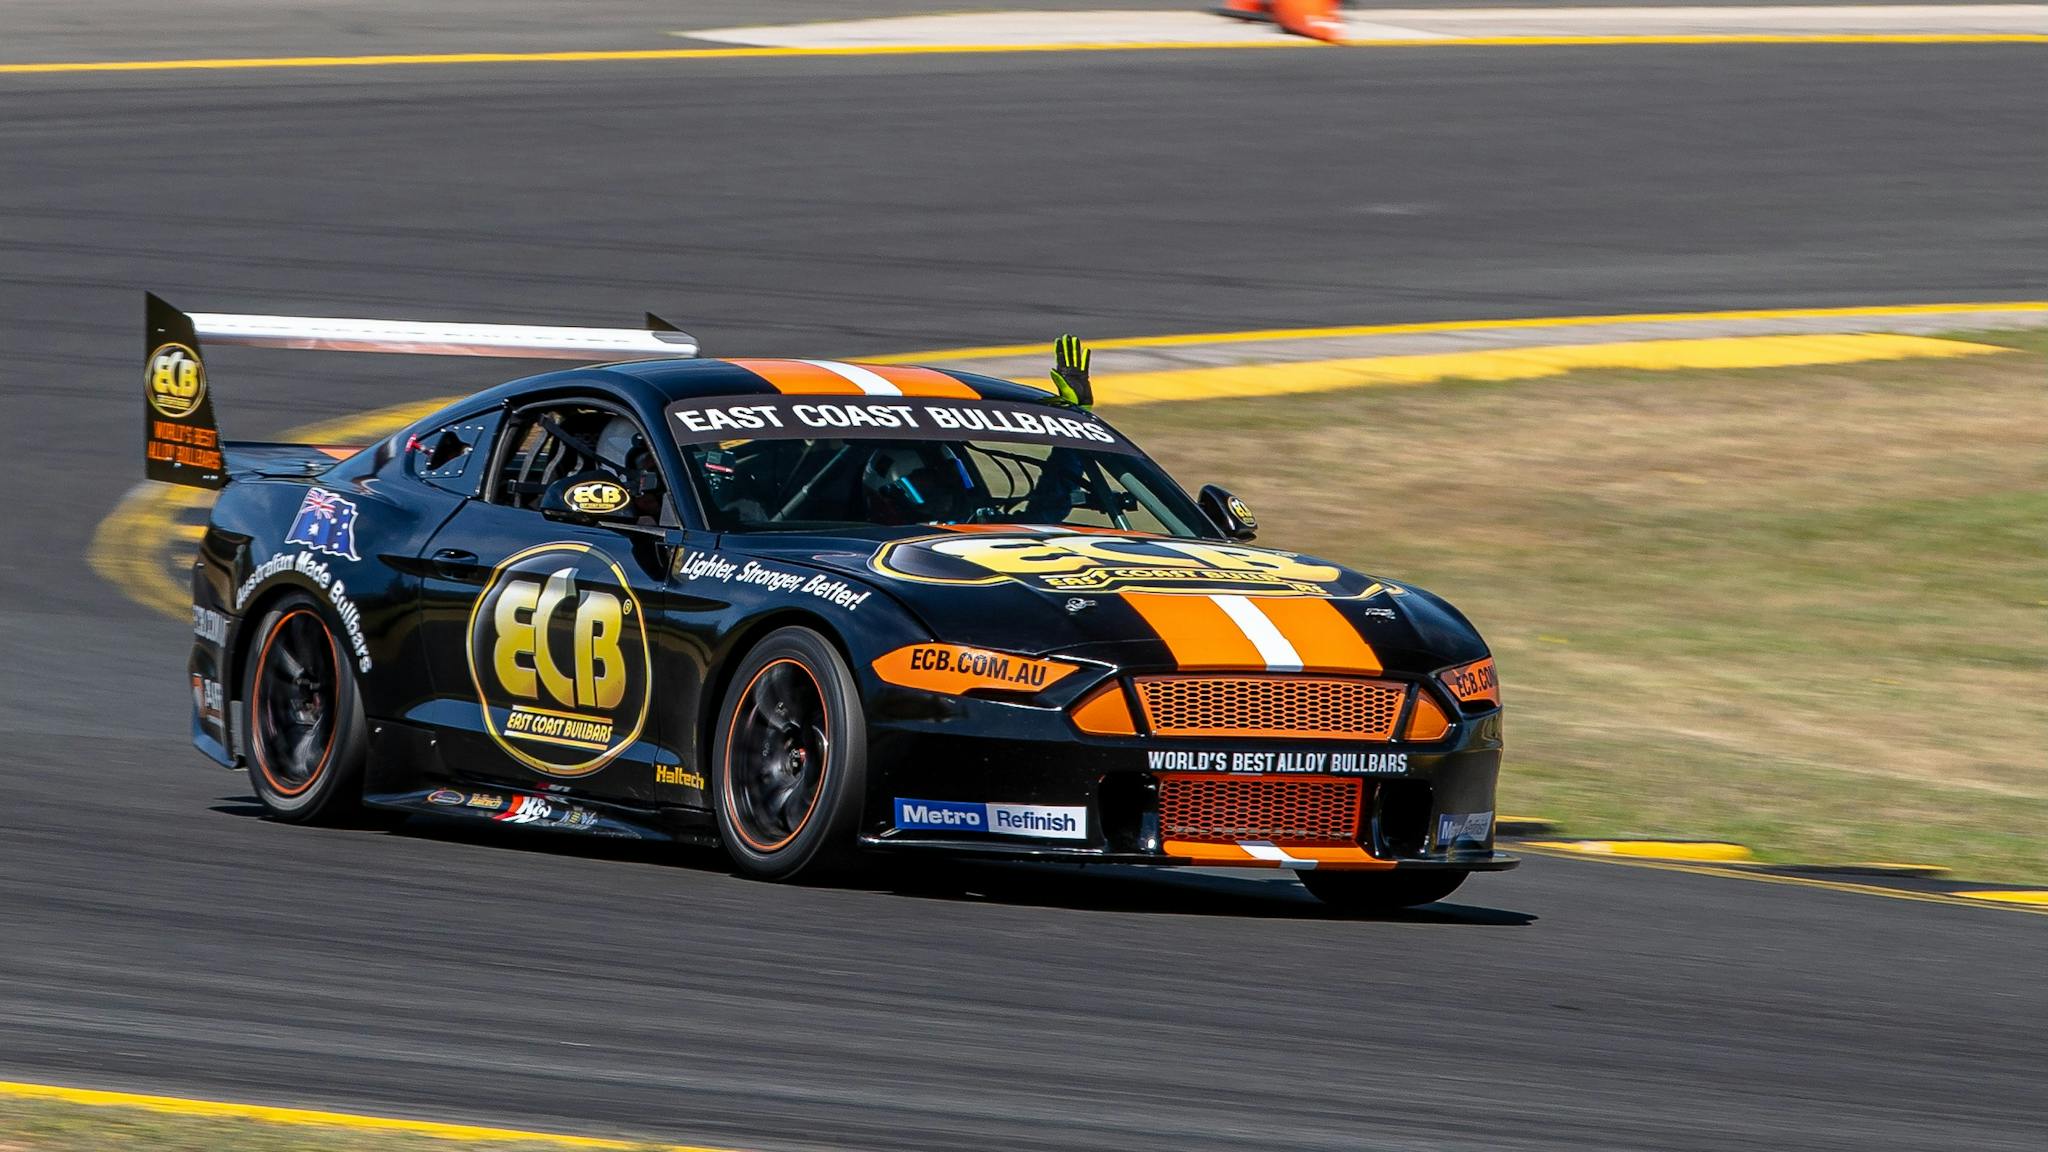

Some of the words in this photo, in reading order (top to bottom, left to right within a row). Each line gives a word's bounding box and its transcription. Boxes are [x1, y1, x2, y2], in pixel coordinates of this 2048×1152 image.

[152, 351, 198, 397] ECB
[675, 405, 784, 433] EAST
[792, 404, 922, 429] COAST
[929, 406, 1116, 445] BULLBARS
[573, 484, 621, 503] ECB
[931, 534, 1340, 583] ECB
[1045, 569, 1110, 586] EAST
[1114, 568, 1199, 579] COAST
[680, 551, 738, 584] Lighter,
[735, 560, 807, 594] Stronger,
[801, 574, 872, 611] Better!
[235, 552, 296, 611] Australian
[294, 551, 332, 589] Made
[328, 579, 373, 673] Bullbars
[493, 567, 626, 710] ECB
[910, 648, 1047, 687] ECB.COM.AU
[506, 712, 534, 731] EAST
[531, 716, 566, 737] COAST
[562, 720, 614, 744] BULLBARS
[656, 764, 705, 790] Haltech
[1148, 751, 1227, 771] WORLD'S
[1232, 753, 1275, 772] BEST
[1277, 753, 1327, 772] ALLOY
[1331, 753, 1408, 773] BULLBARS
[903, 804, 981, 826] Metro
[996, 809, 1077, 832] Refinish
